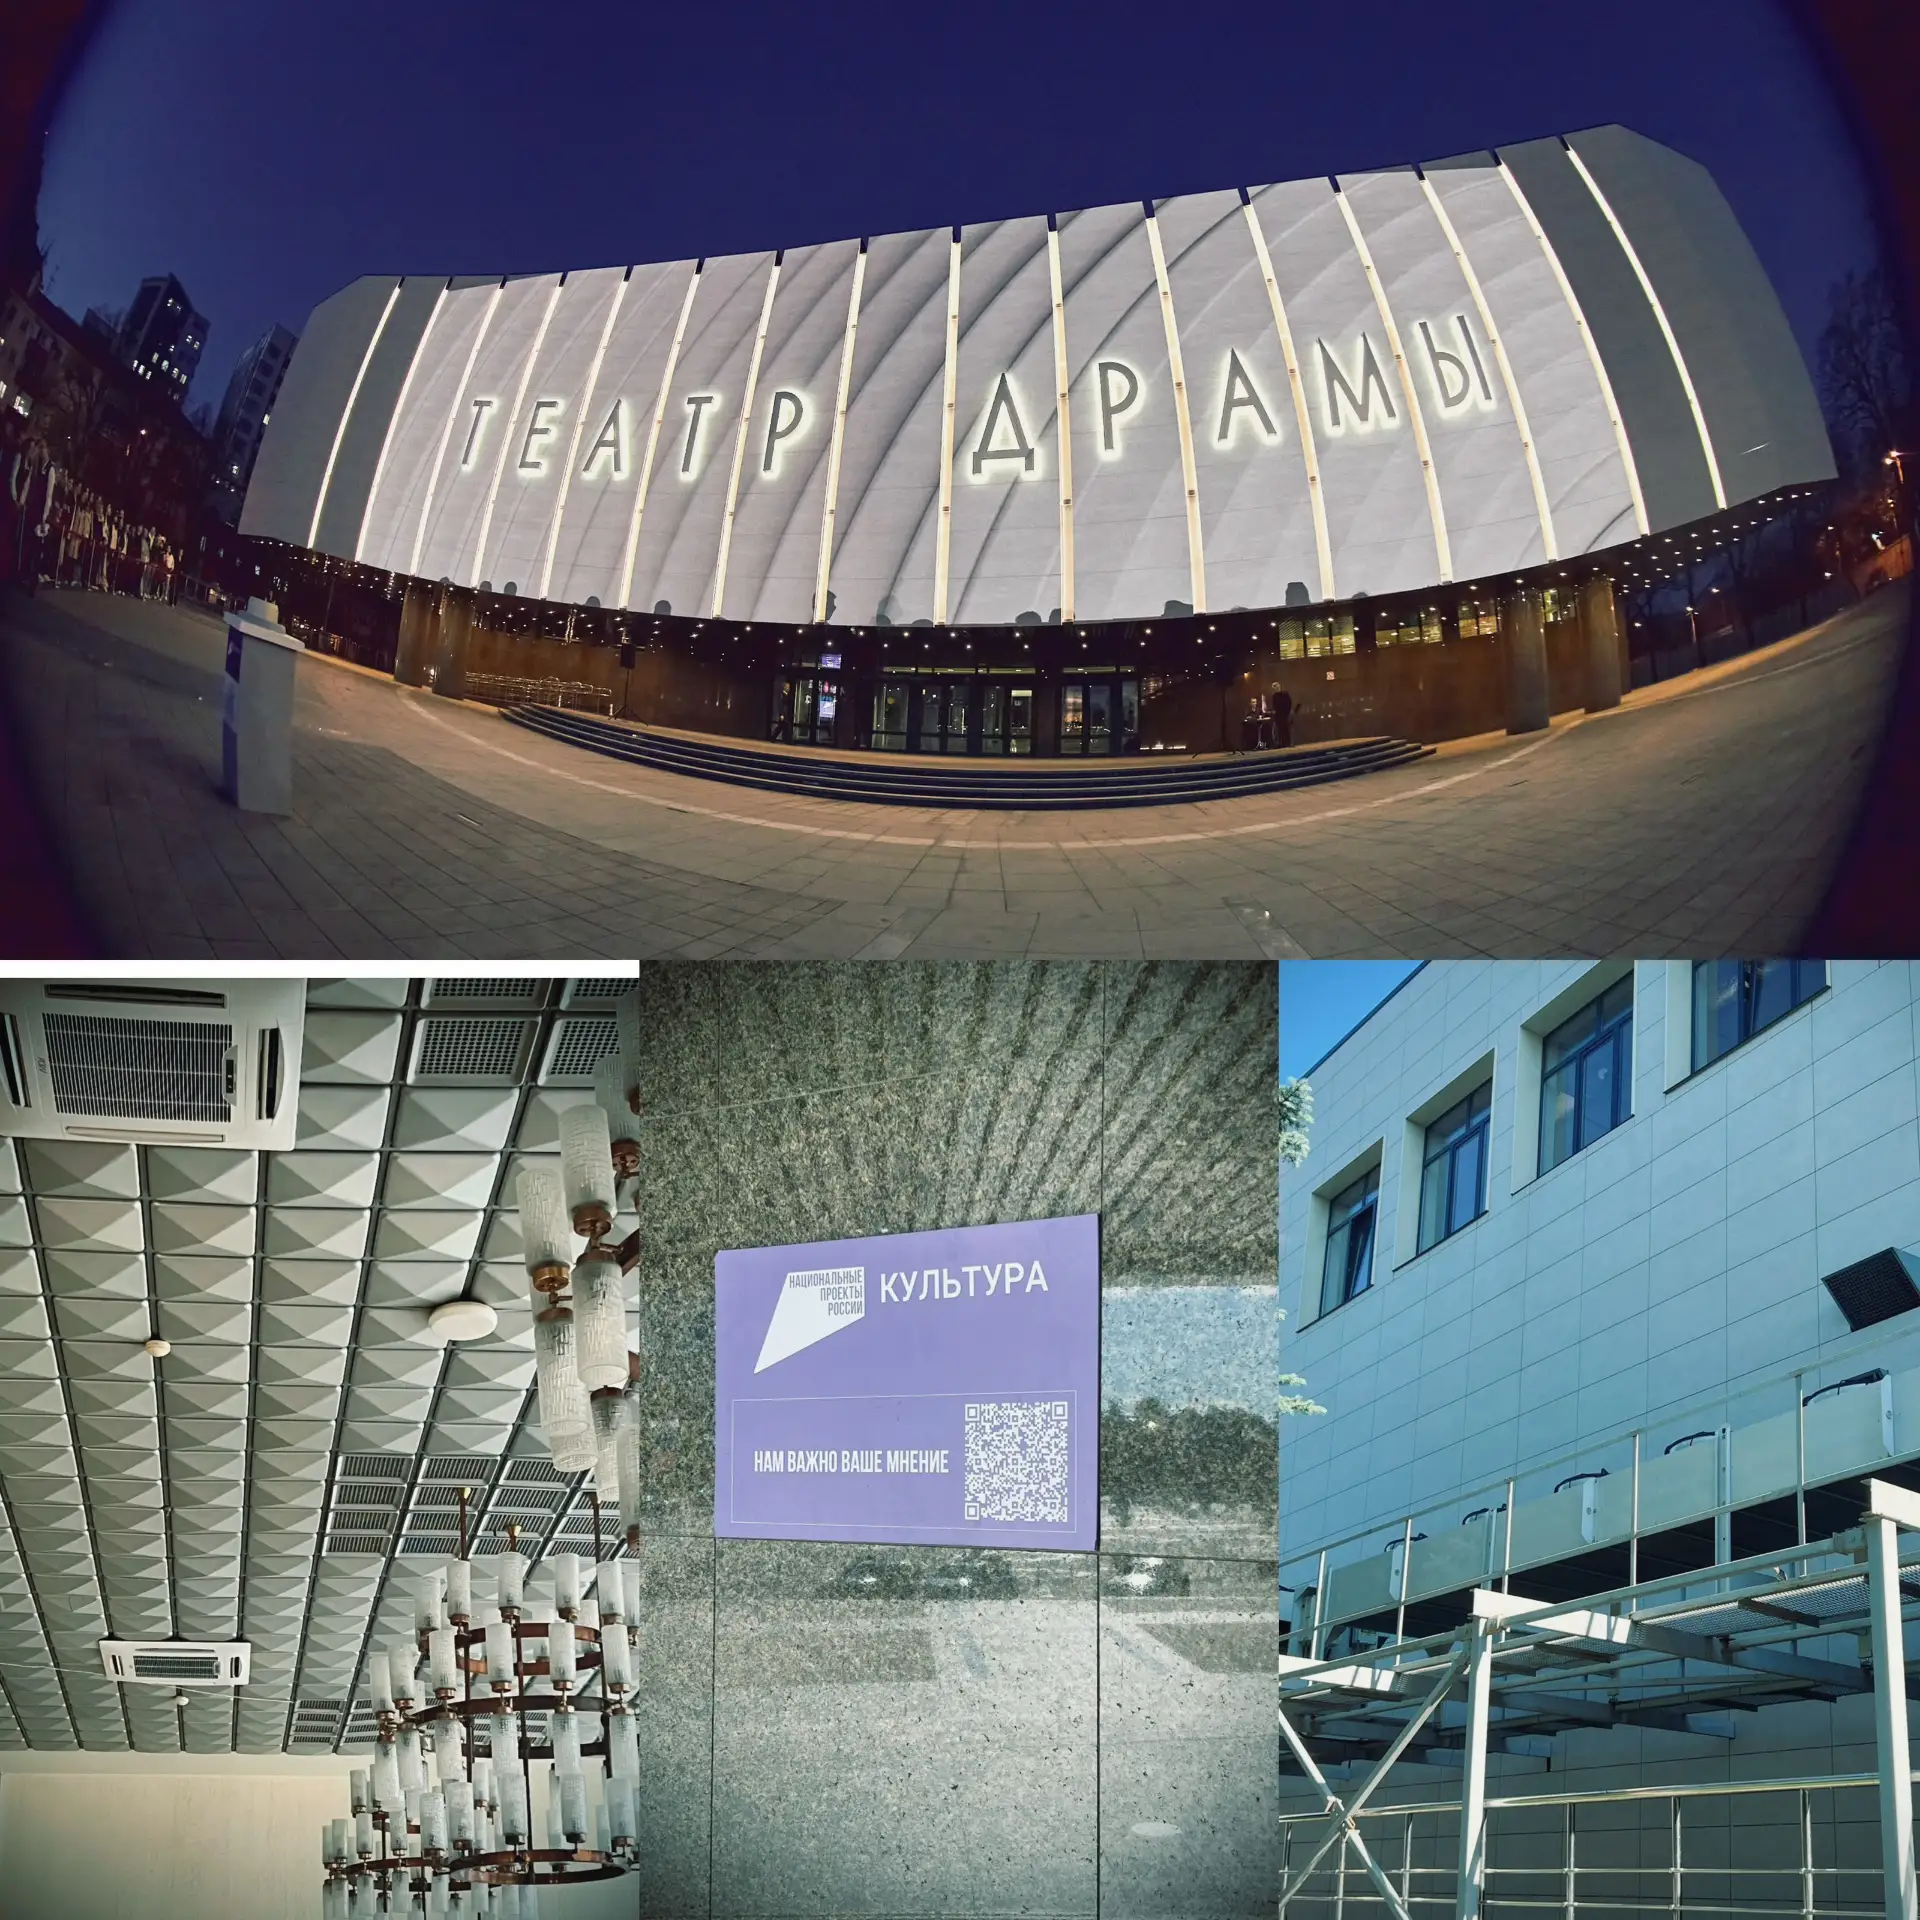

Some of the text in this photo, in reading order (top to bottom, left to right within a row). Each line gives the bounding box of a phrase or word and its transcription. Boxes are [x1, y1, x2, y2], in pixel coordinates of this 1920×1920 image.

[462, 315, 1493, 475] ТЕАТР ДРАМЫ
[789, 1269, 863, 1289] НАЦИОНАЛЬНЫЕ
[880, 1260, 1049, 1303] КУЛЬТУРА
[820, 1285, 863, 1302] ПРОЕКТЫ
[828, 1300, 863, 1316] РОССИИ
[754, 1450, 950, 1474] НАМ ВАЖНО ВАШЕ МНЕНИЕ
